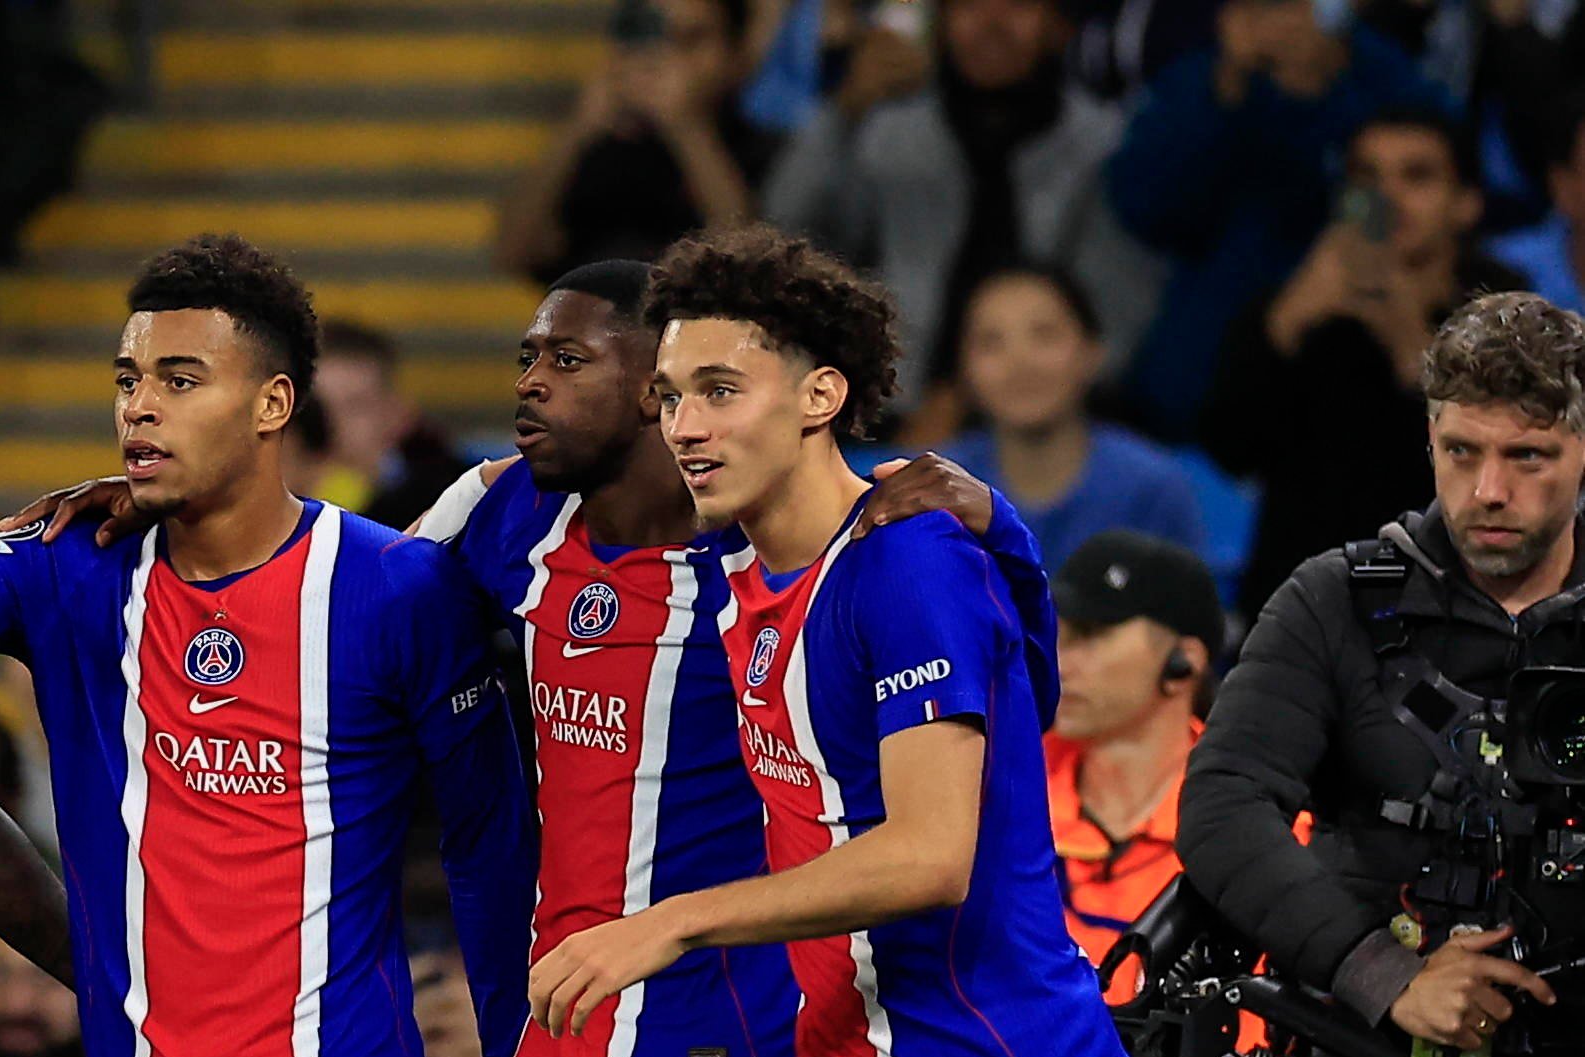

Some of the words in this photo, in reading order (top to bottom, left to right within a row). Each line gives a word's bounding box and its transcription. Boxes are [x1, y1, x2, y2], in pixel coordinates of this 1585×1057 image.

[583, 586, 614, 604] PARIS
[194, 631, 233, 648] PARIS
[875, 658, 951, 703] EYOND
[534, 681, 627, 731] QATAR
[154, 732, 285, 772] QATAR
[550, 719, 627, 754] AIRWAYS
[185, 771, 287, 796] AIRWAYS
[751, 754, 811, 788] AIRWAYS
